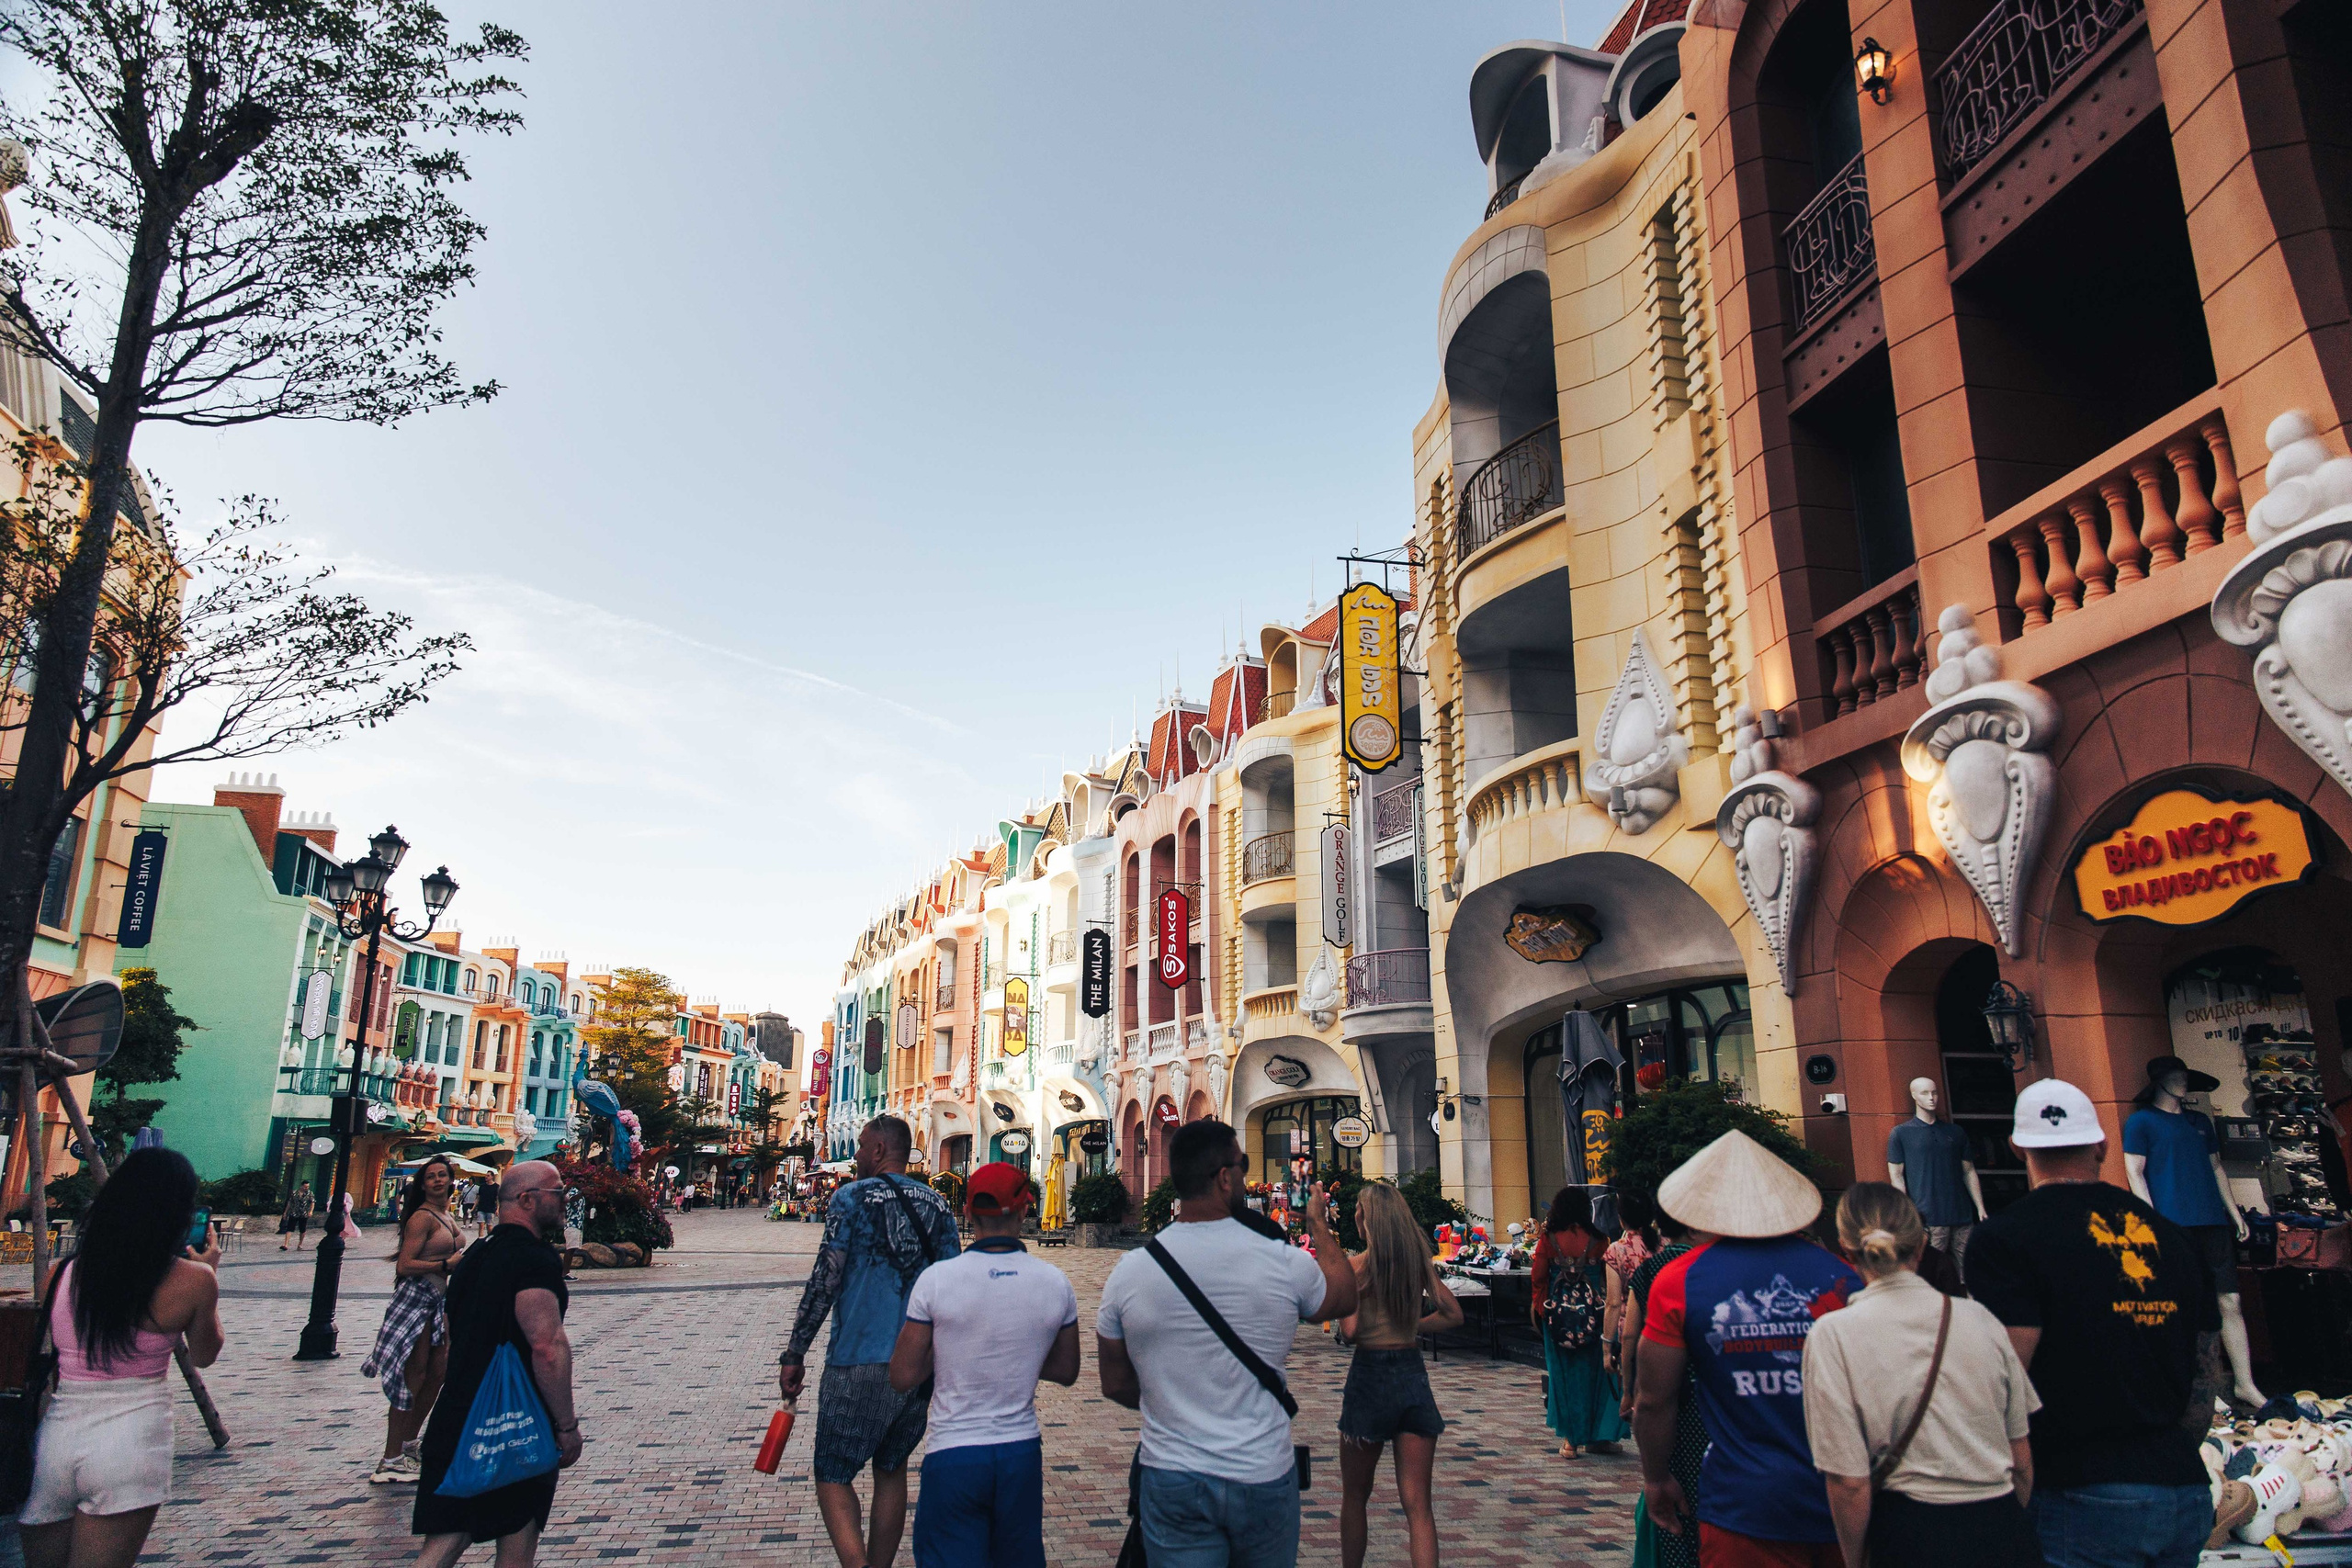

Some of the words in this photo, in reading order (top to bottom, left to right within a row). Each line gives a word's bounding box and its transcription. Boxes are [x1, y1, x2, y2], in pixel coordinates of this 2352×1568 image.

[2165, 811, 2257, 860] NGỌC
[1334, 829, 1345, 894] ORANGE
[2102, 852, 2281, 911] ВЛАДИВОСТОК
[130, 890, 146, 931] COFFEE
[1168, 900, 1177, 953] SAKOS
[1336, 897, 1346, 942] GOLF
[1091, 938, 1102, 980] MILAN
[1091, 984, 1102, 1008] THE
[1730, 1322, 1814, 1338] FEDERATIO
